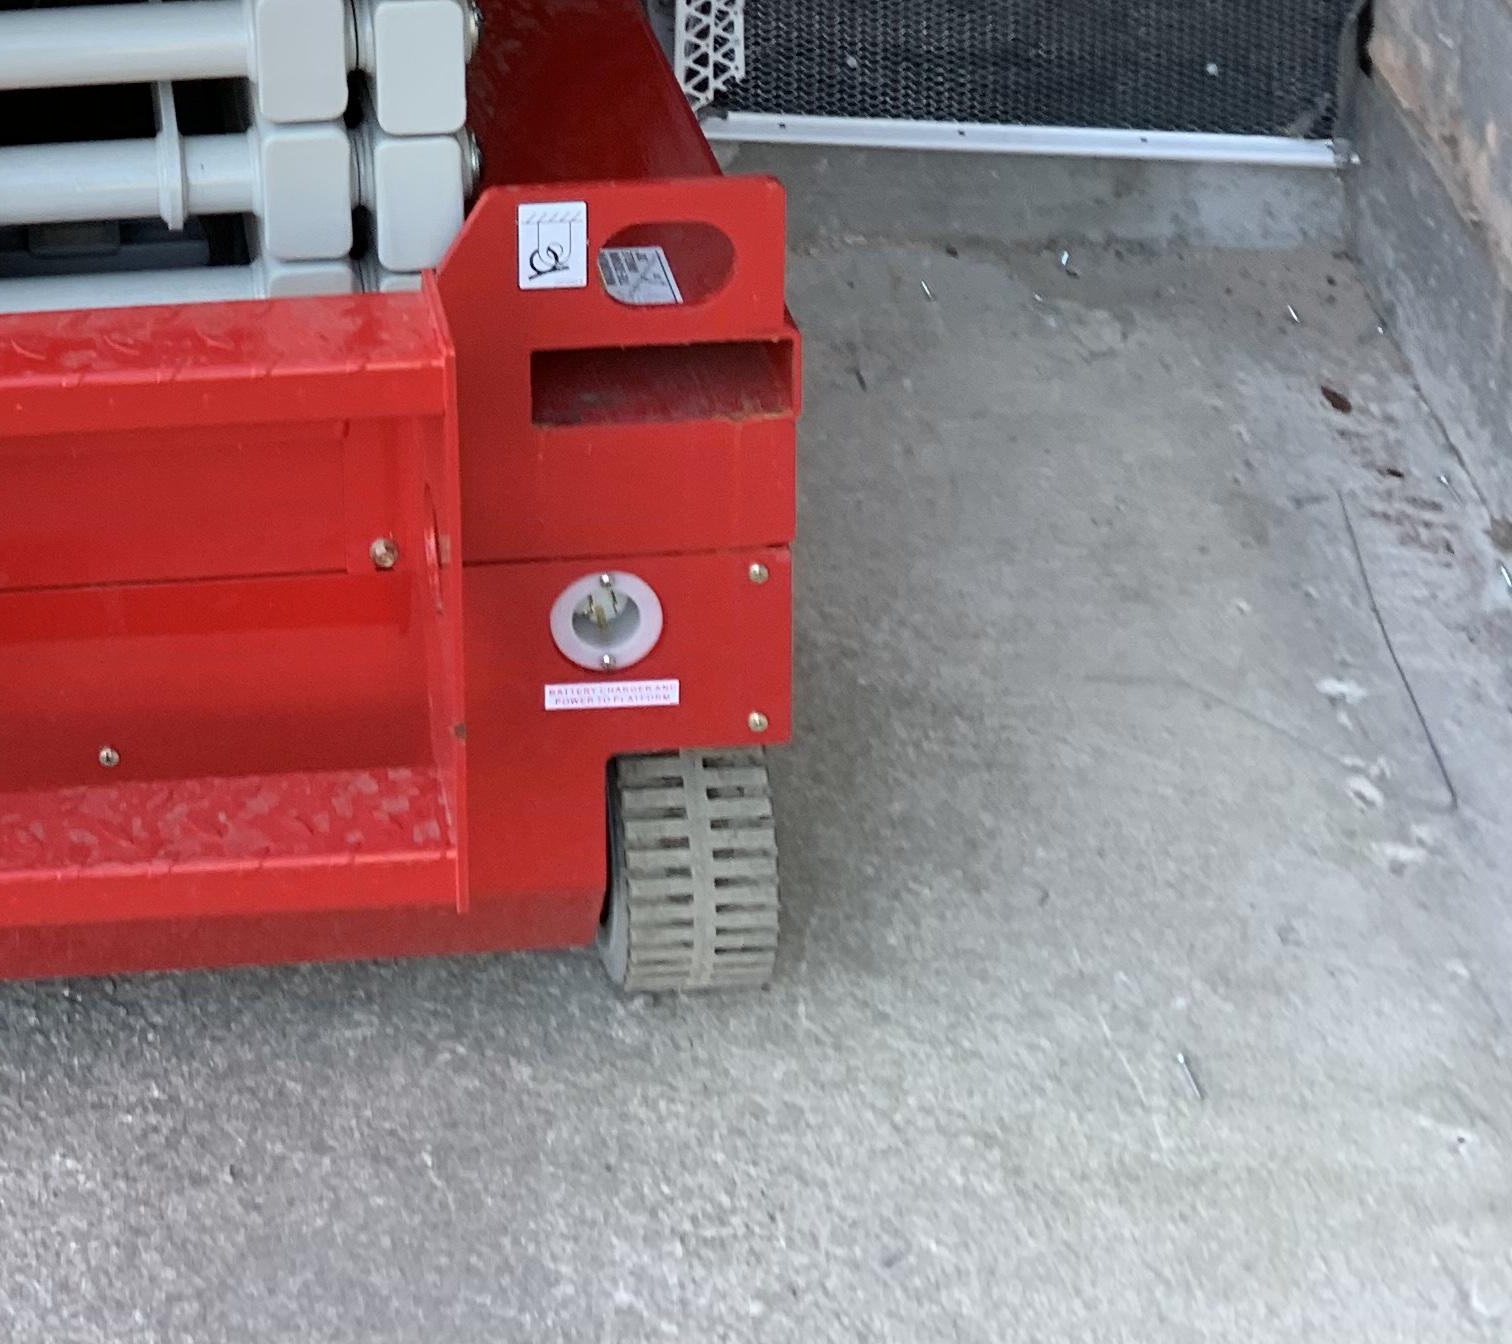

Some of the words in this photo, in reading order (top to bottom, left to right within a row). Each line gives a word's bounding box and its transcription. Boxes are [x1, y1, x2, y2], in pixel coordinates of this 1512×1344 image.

[549, 686, 596, 695] BATTERY
[599, 685, 652, 693] CHARGER
[655, 684, 675, 692] AND
[555, 697, 594, 705] POWER
[597, 696, 610, 704] TO
[613, 694, 671, 703] PLATFORM
